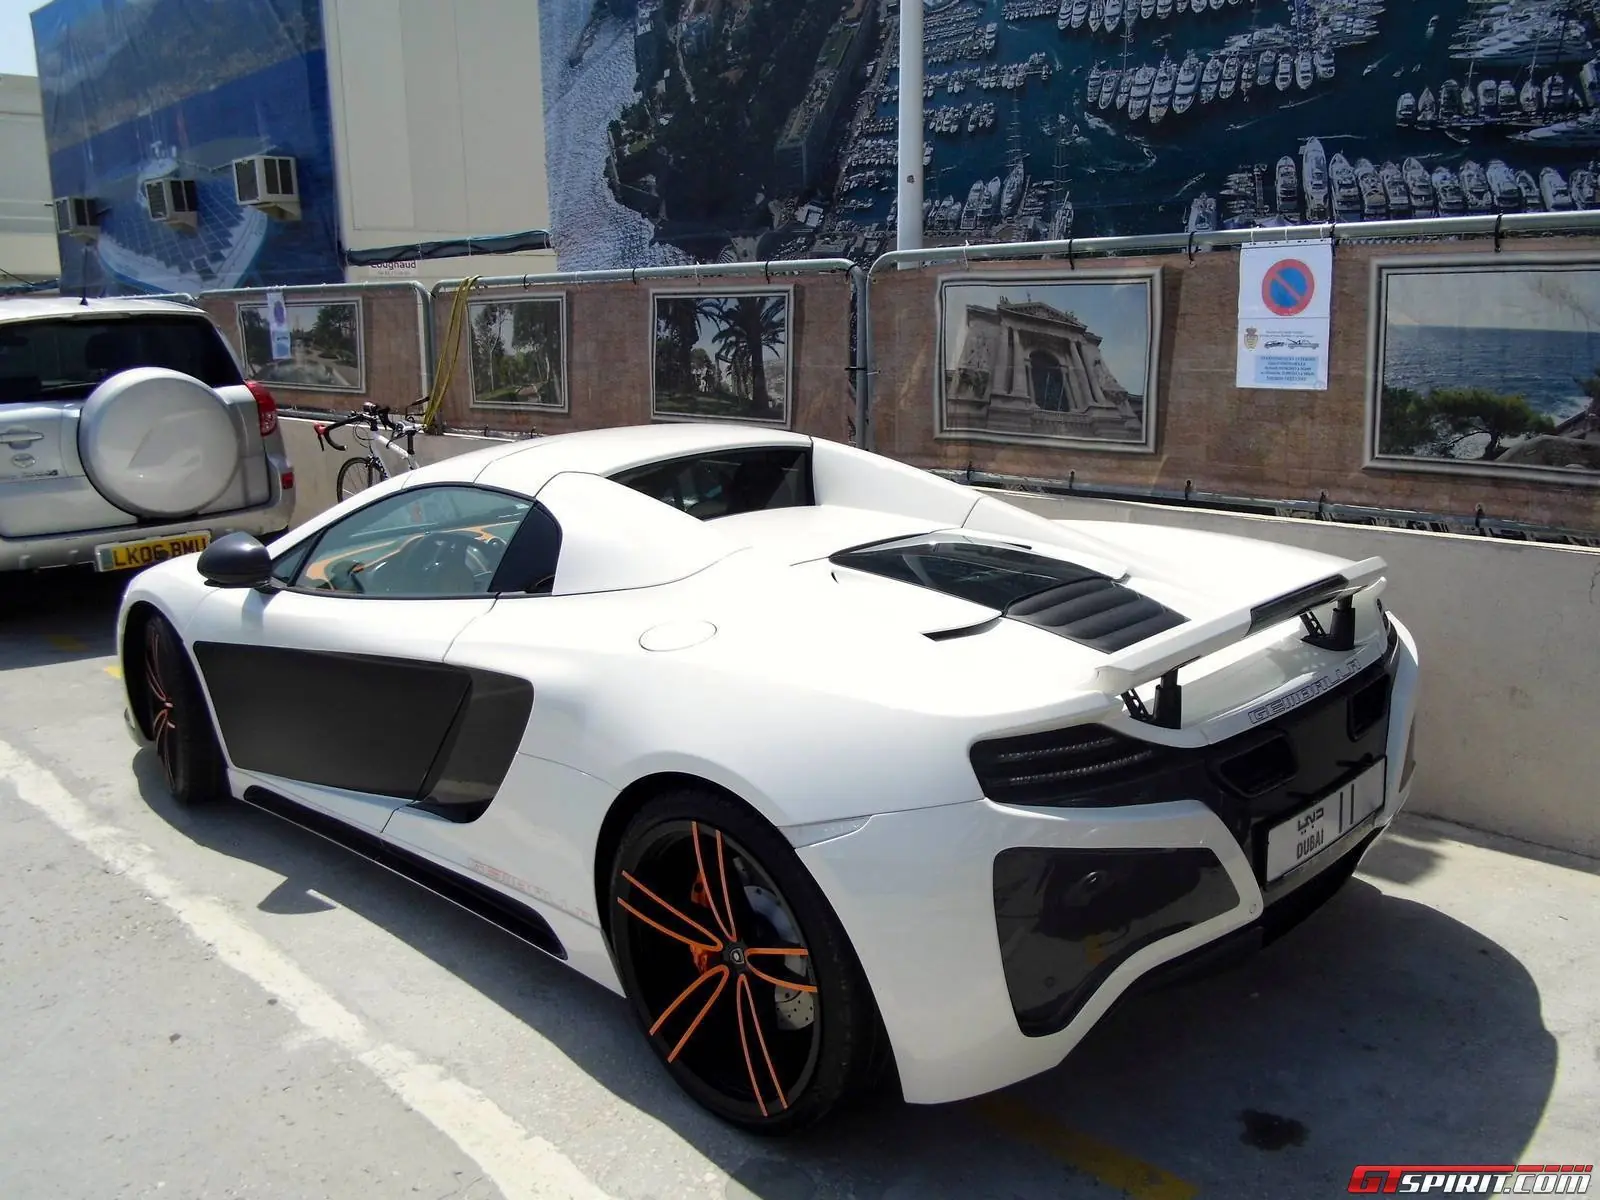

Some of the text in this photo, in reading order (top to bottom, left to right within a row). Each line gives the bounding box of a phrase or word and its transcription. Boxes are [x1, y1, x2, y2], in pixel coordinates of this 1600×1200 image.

[1248, 658, 1362, 725] GEMBALLA
[1297, 807, 1324, 835] دبي
[1296, 828, 1324, 860] DUBAI
